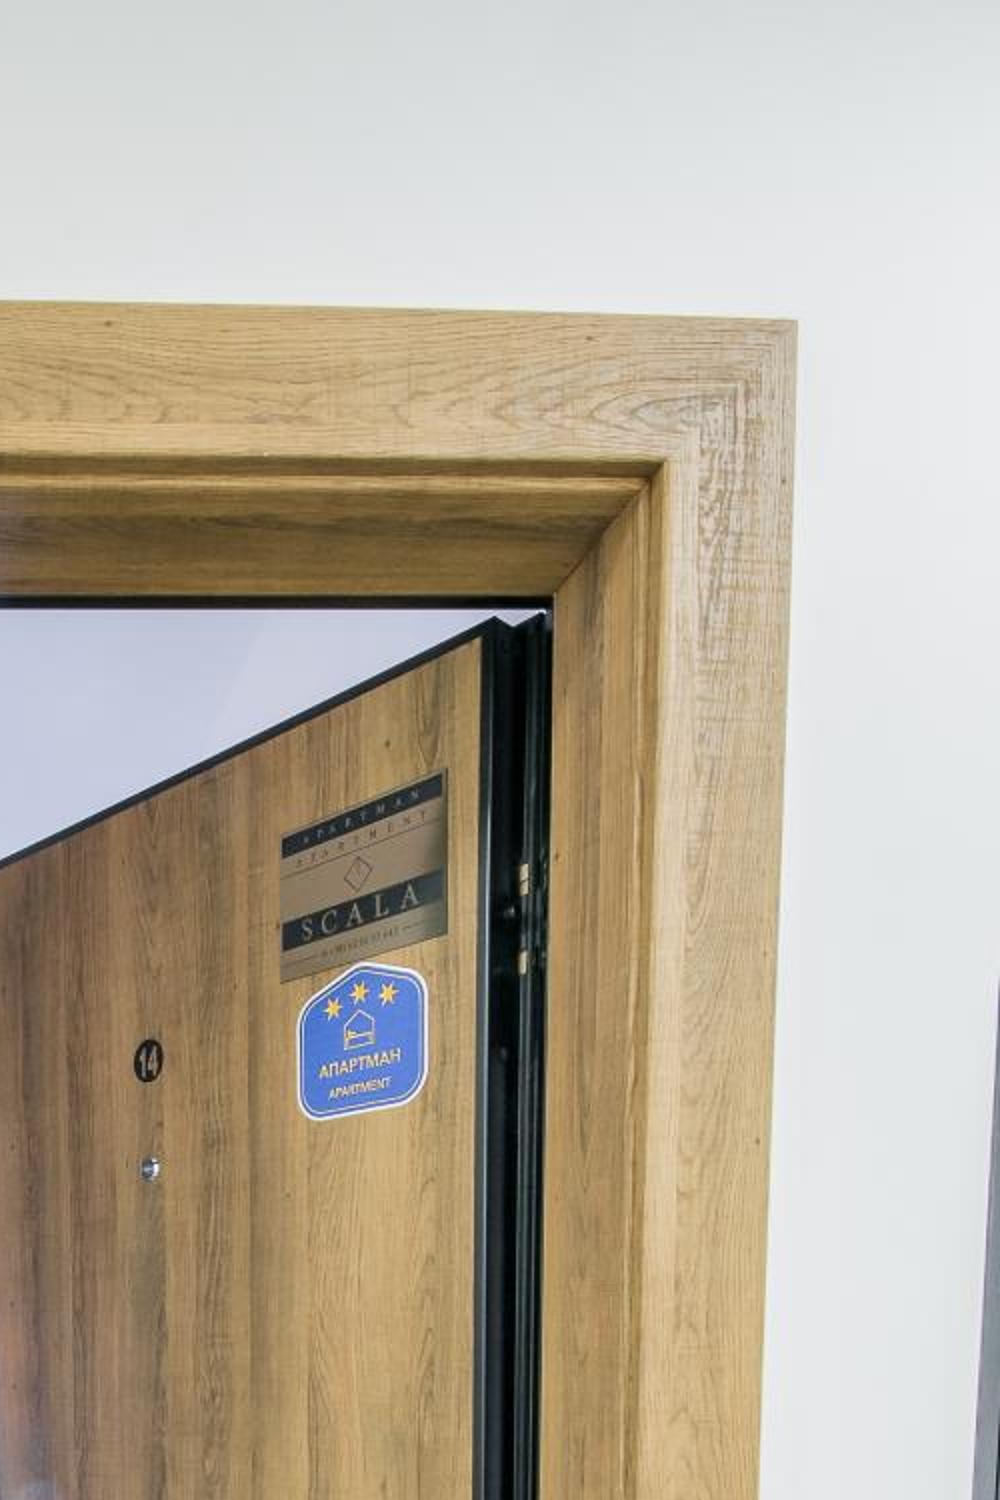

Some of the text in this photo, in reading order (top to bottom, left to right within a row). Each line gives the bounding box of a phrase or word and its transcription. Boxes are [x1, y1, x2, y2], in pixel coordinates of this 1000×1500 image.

[300, 882, 421, 941] SCALA
[139, 1046, 159, 1079] 14
[319, 1048, 401, 1080] АПАРТМАН
[328, 1077, 393, 1100] APARTMENT
